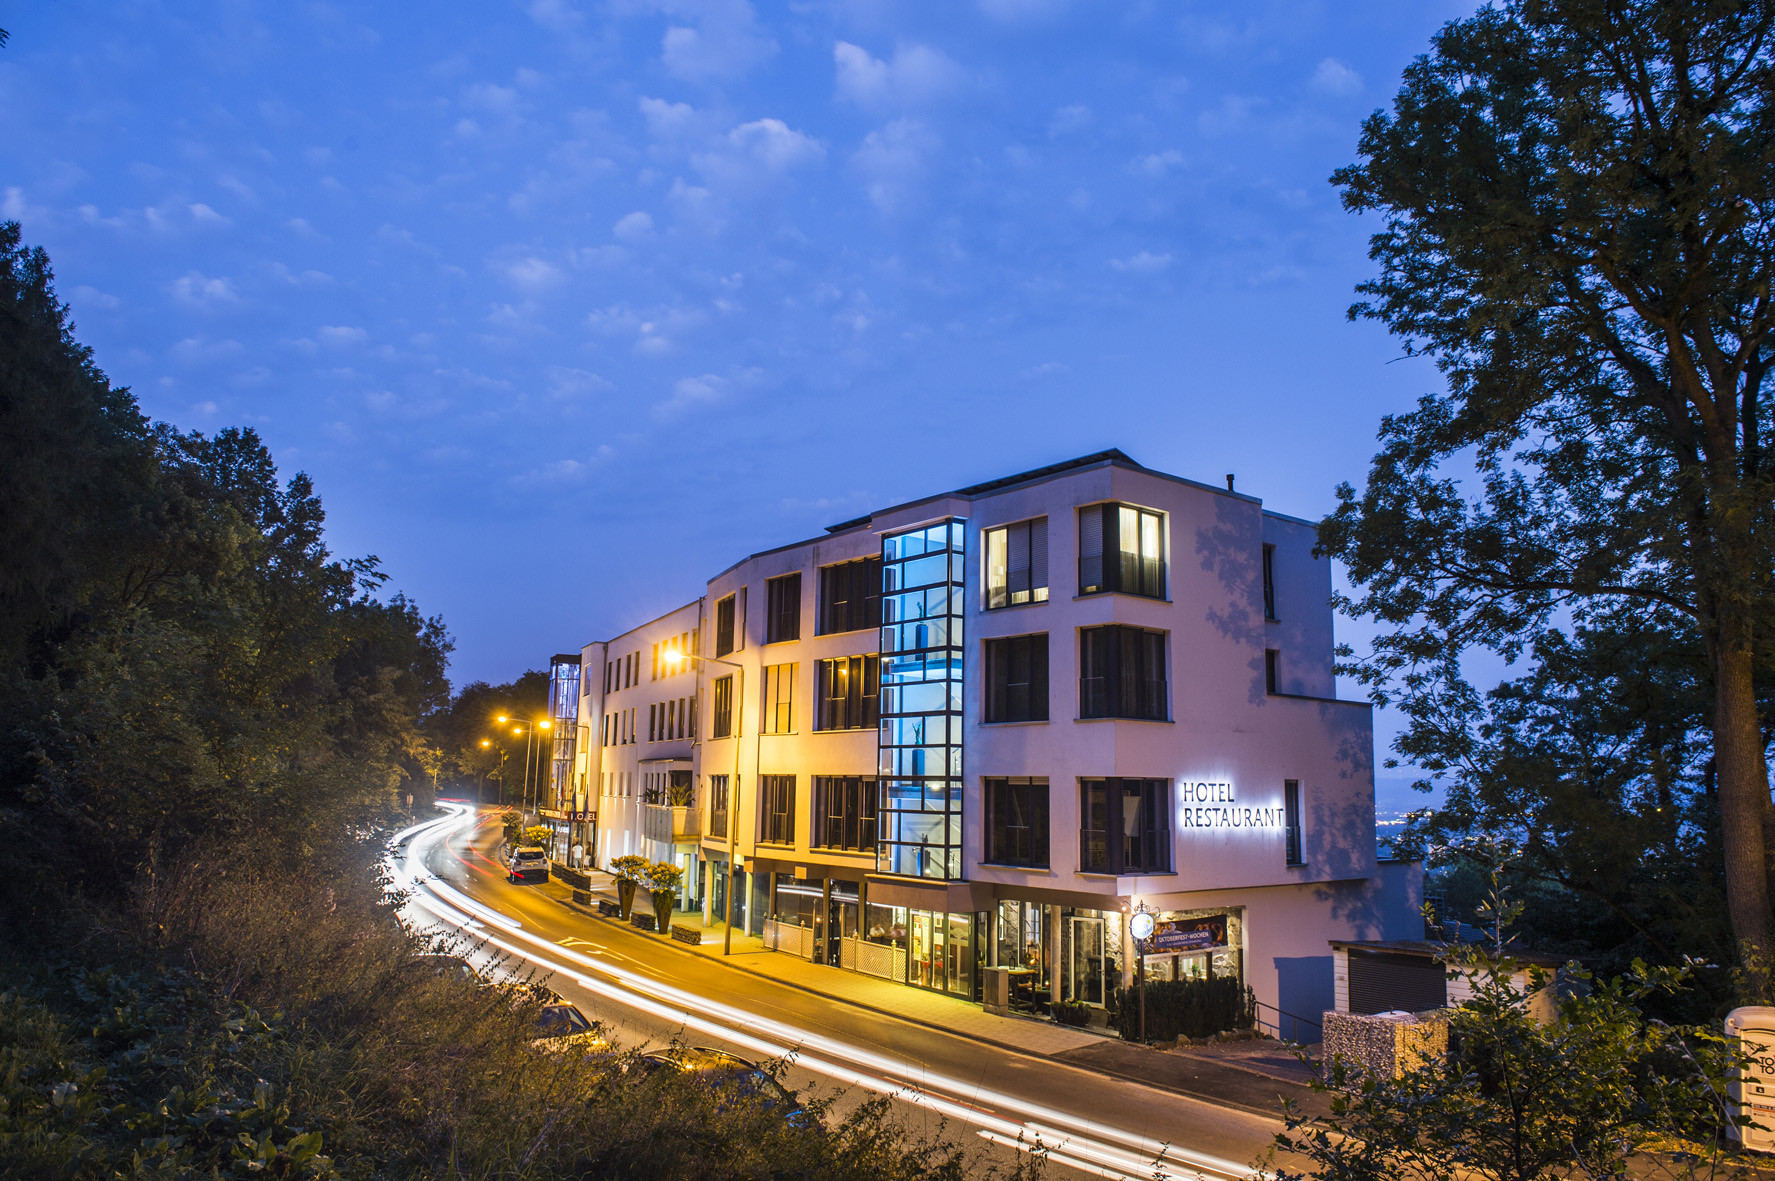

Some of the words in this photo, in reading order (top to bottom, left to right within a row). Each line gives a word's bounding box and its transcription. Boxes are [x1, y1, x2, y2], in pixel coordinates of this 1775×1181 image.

[1183, 782, 1235, 802] HOTEL
[570, 812, 597, 821] OEL
[1184, 808, 1284, 828] RESTAURANT
